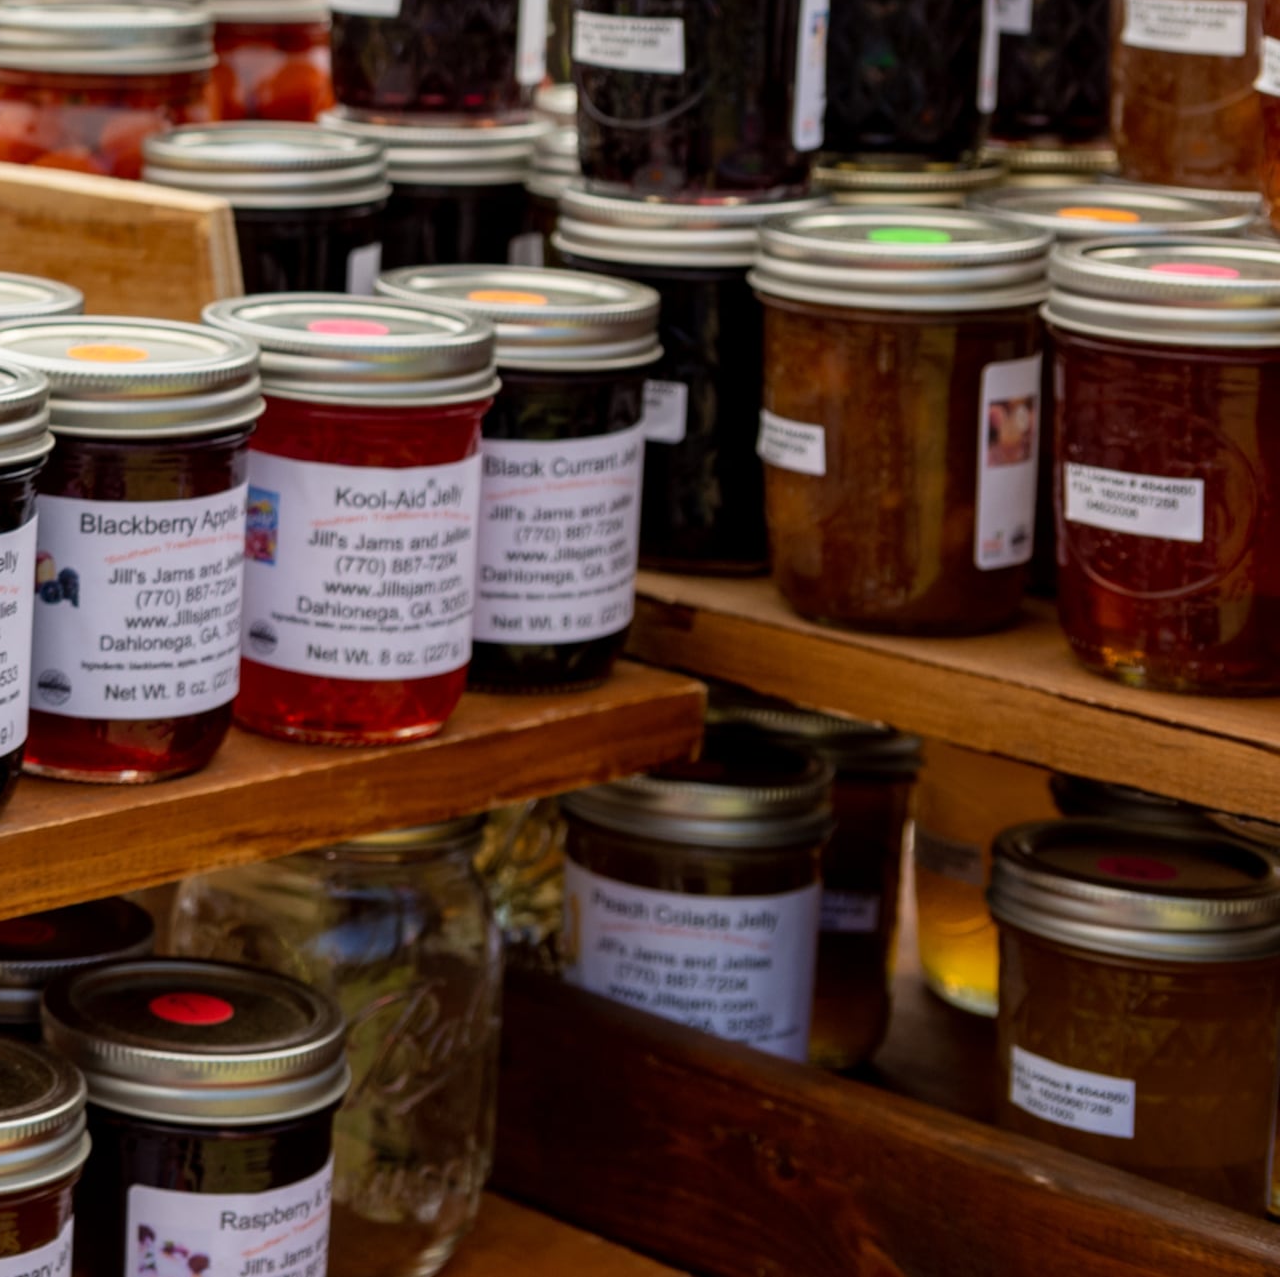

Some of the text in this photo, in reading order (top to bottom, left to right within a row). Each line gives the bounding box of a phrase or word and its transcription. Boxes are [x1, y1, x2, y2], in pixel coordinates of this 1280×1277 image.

[80, 503, 238, 537] Blackberry Apple
[354, 534, 403, 551] Jams
[410, 532, 438, 548] and
[220, 1201, 312, 1231] Raspberry
